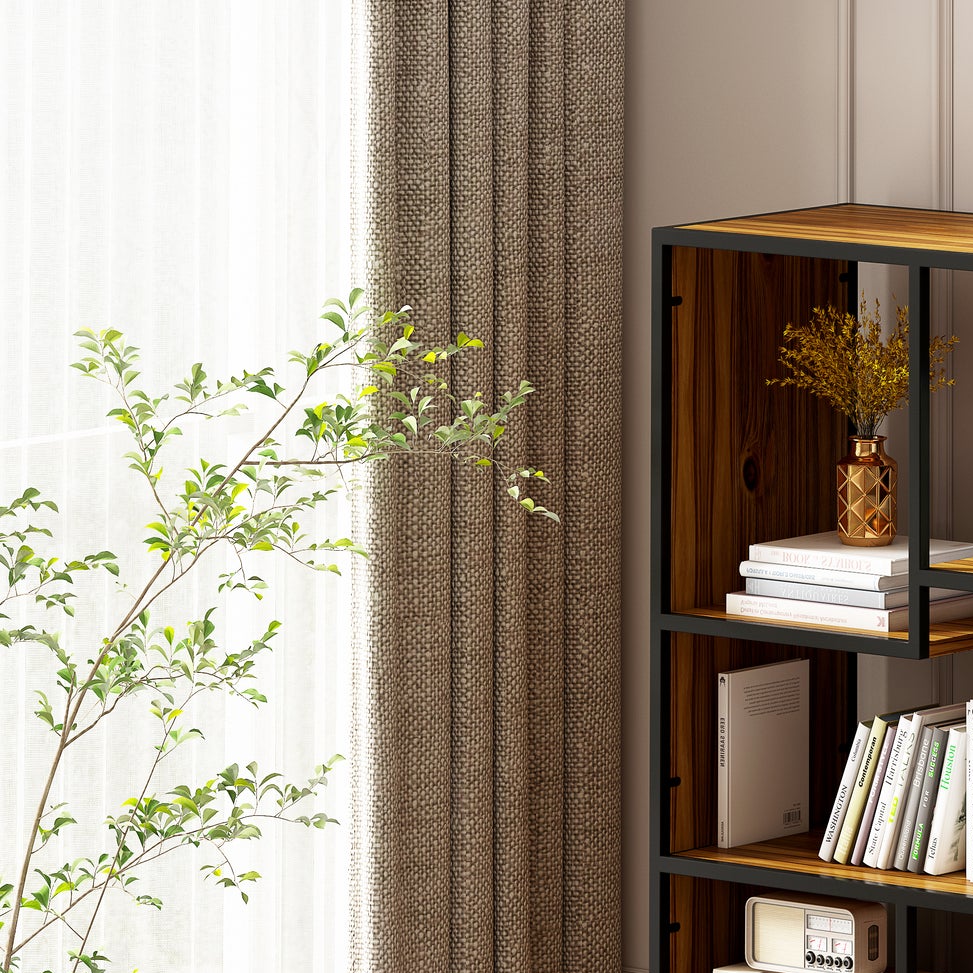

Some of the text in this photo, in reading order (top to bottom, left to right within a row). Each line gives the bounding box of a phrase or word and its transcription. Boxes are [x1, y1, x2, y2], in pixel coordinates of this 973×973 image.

[868, 730, 908, 855] State Capital Harrisburg
[913, 738, 930, 788] Brisbane
[941, 744, 957, 790] Houston
[825, 784, 848, 843] WASHINGTON
[911, 741, 940, 860] FORMULA FOR SUCCESS
